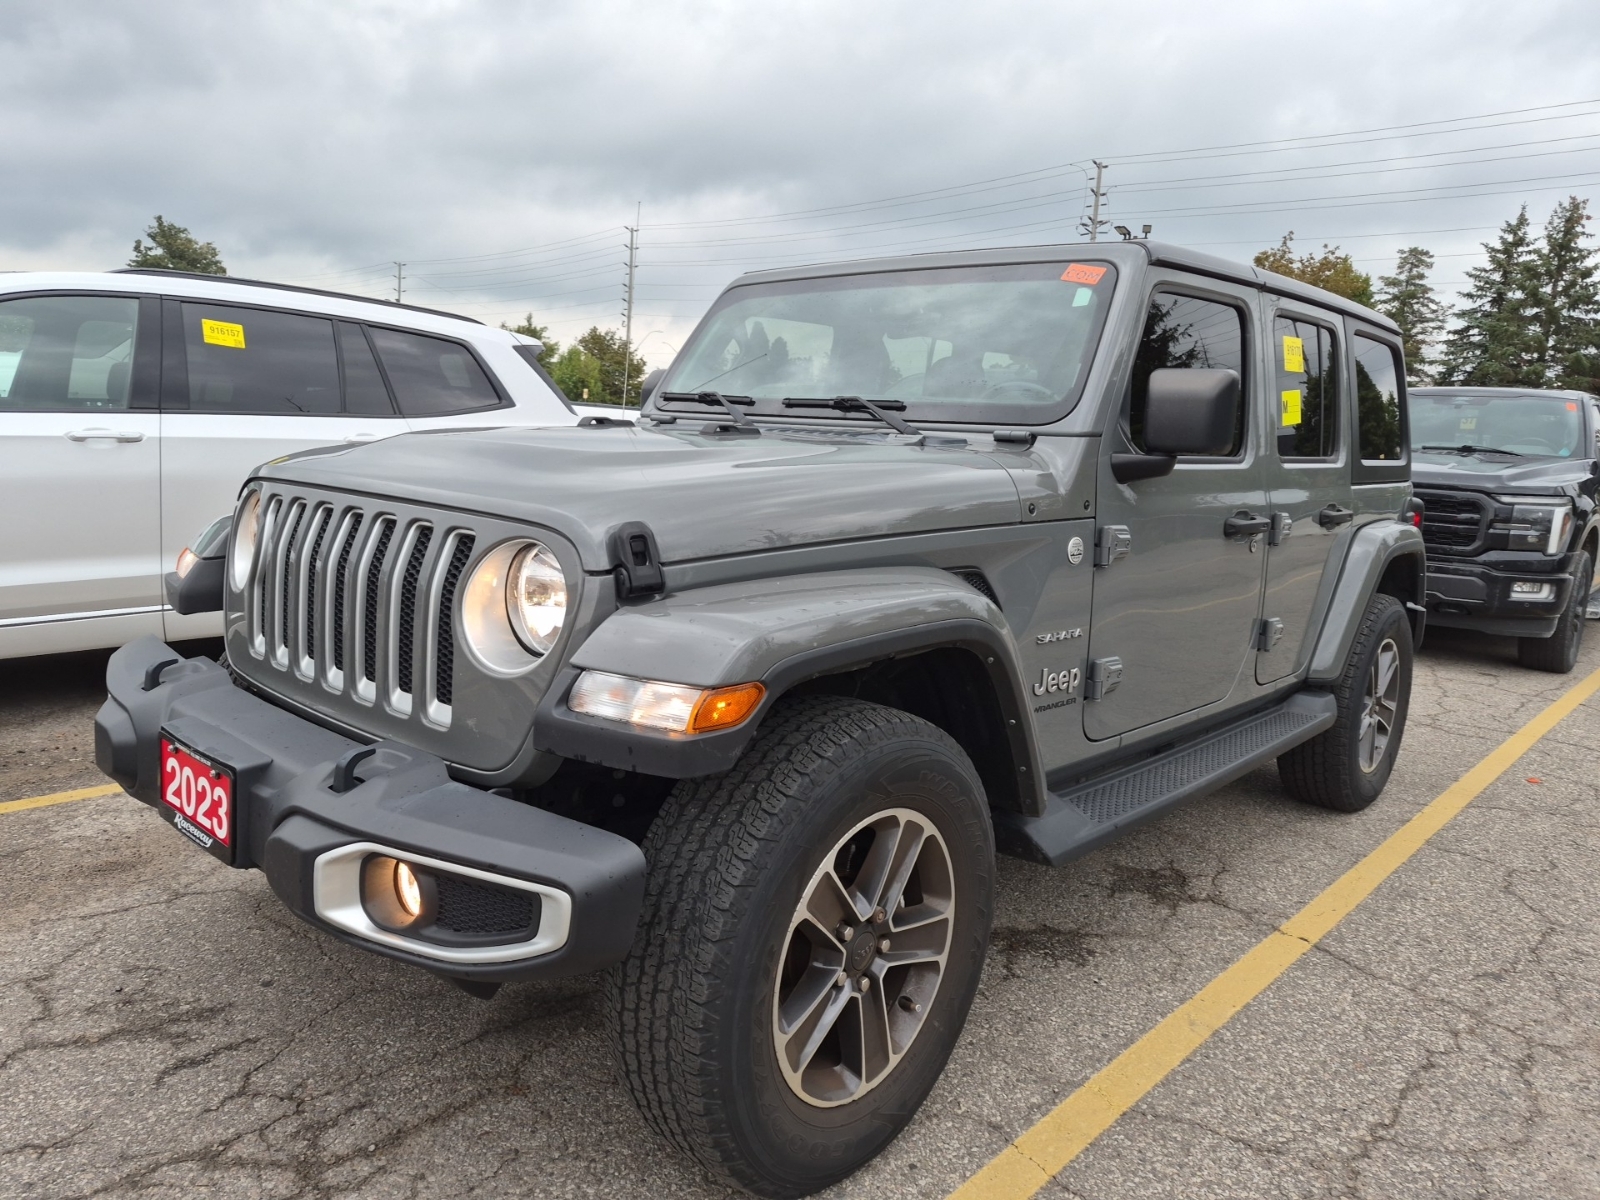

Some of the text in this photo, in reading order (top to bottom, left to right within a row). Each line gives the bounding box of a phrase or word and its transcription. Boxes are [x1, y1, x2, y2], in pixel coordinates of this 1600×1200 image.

[209, 326, 240, 338] 916157
[1036, 628, 1083, 645] SAHARA
[1033, 667, 1081, 696] Jeep
[1034, 697, 1077, 713] WRANGLER
[166, 756, 228, 839] 2023
[174, 811, 213, 848] Raceway
